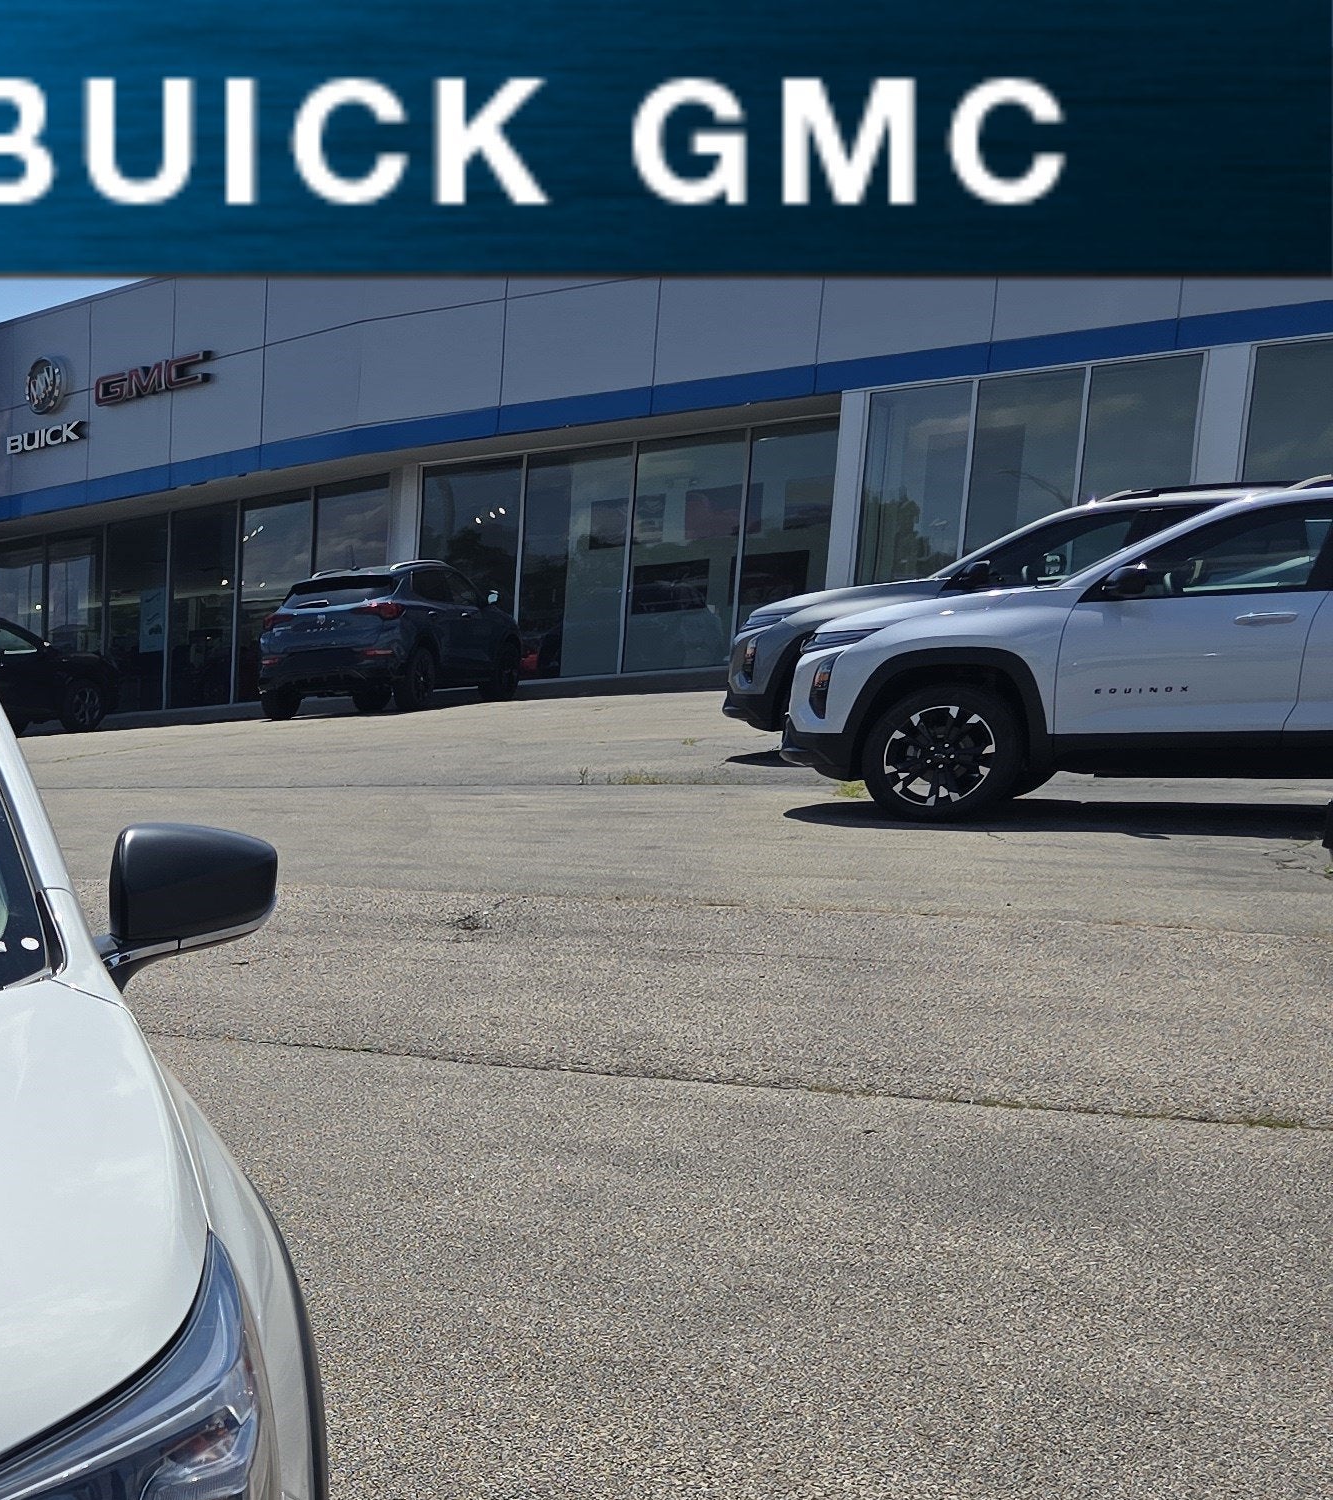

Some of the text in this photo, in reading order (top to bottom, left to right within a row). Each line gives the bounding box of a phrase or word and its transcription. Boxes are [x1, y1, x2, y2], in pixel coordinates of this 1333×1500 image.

[94, 350, 208, 408] GMC
[6, 419, 84, 455] BUICK
[1094, 685, 1189, 695] EQUINOX
